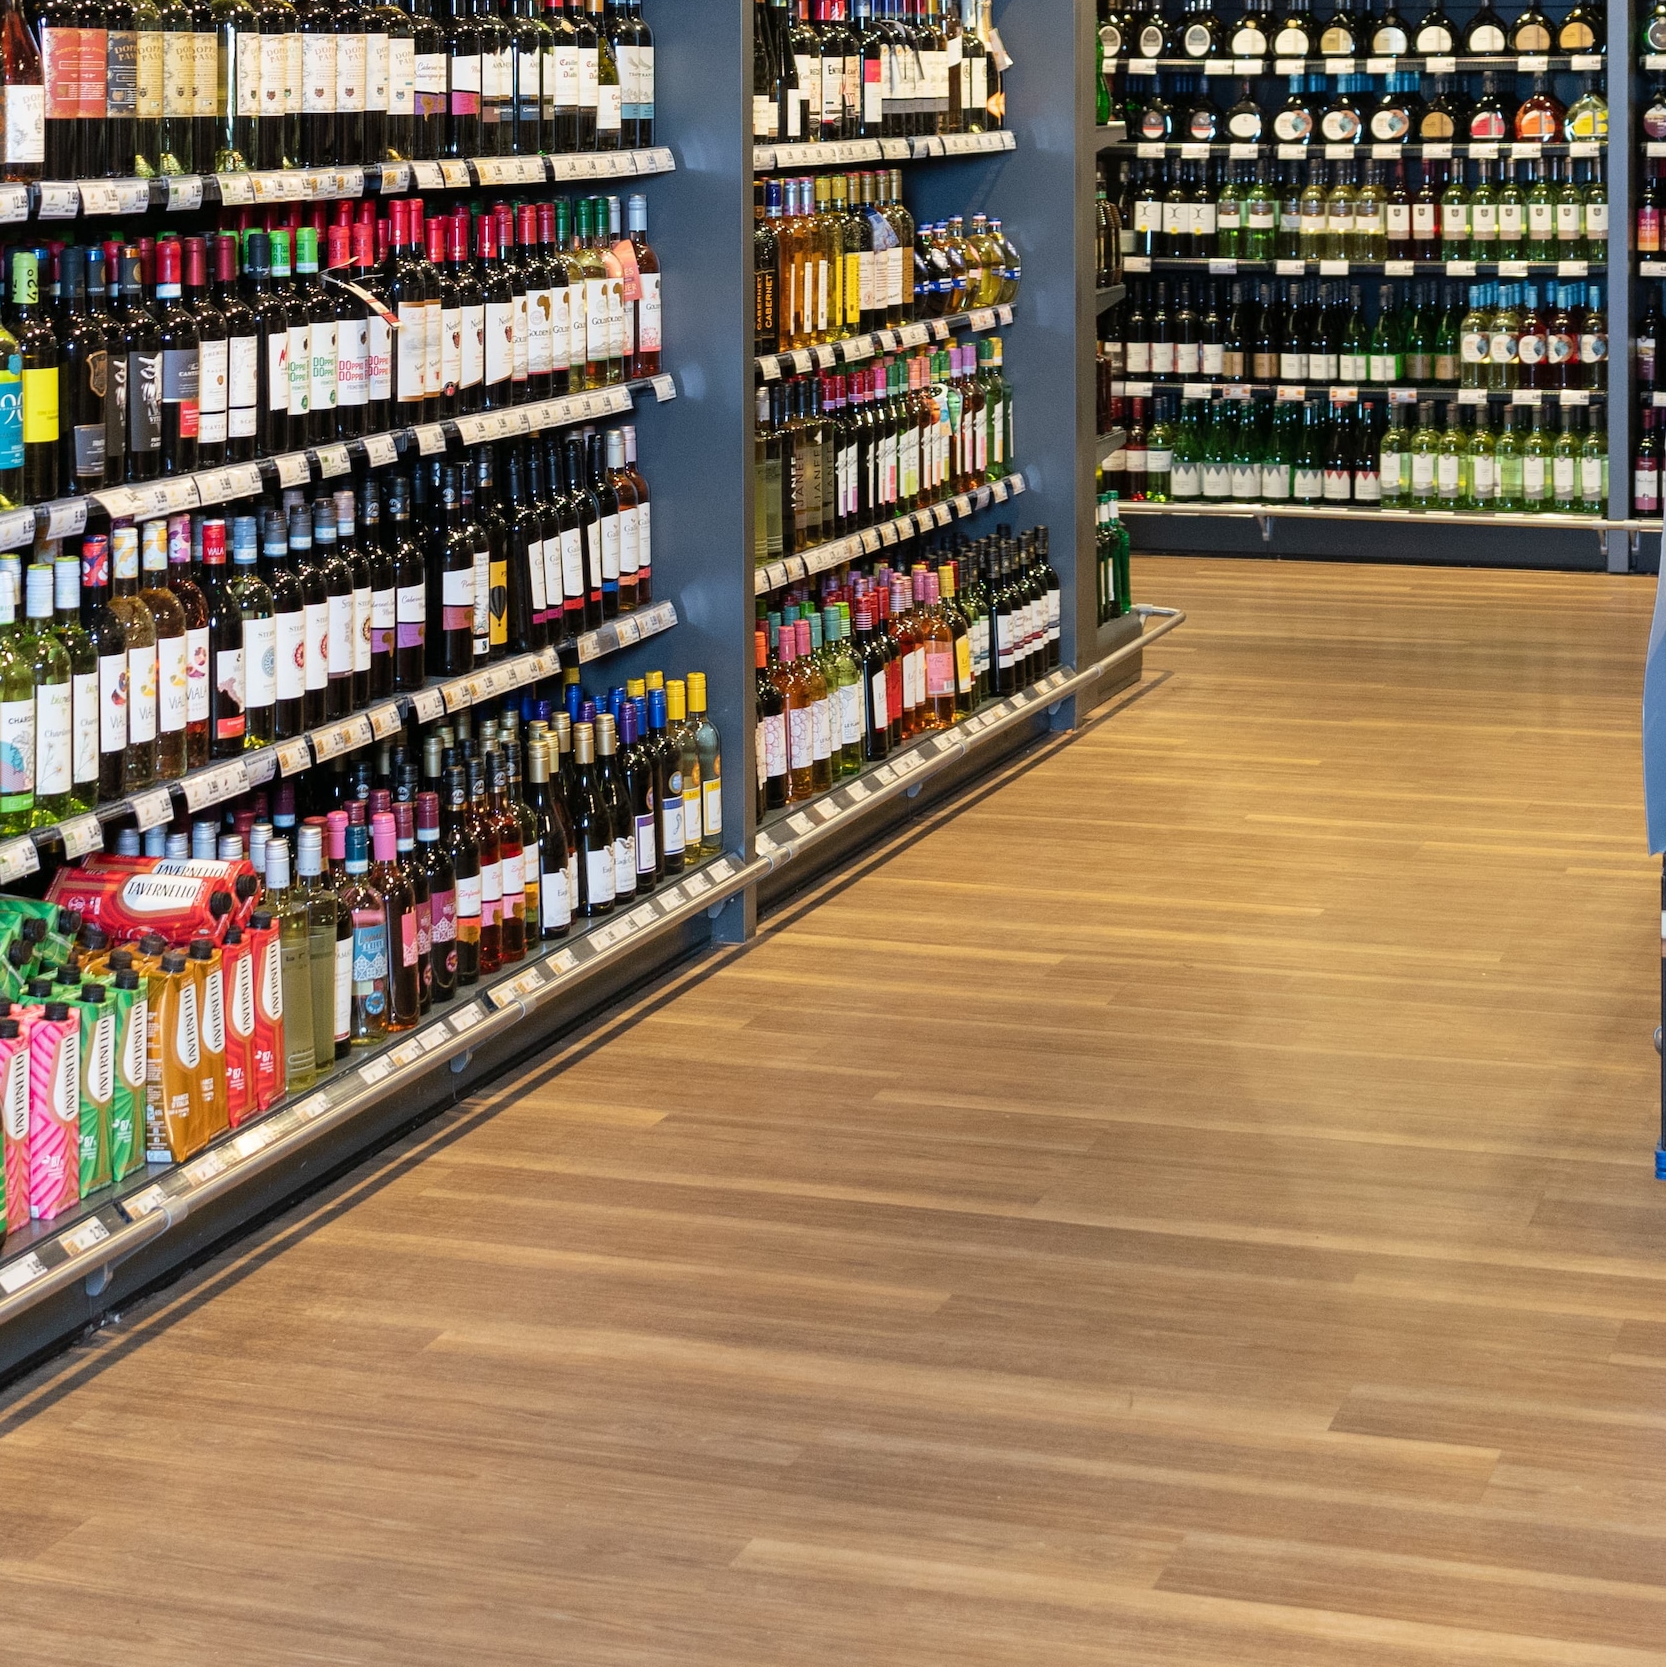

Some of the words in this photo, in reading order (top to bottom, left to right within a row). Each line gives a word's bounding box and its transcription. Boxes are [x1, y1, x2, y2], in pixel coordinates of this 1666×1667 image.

[765, 274, 773, 329] CABERNET
[126, 880, 197, 902] TAVERNELLO
[242, 957, 252, 1033] TAVERNELLO
[65, 1035, 76, 1118] TAVERNELLO
[98, 1018, 110, 1100] TAVERNELLO
[134, 1003, 143, 1084] TAVERNELLO
[13, 1053, 25, 1136] TAVERNELLO
